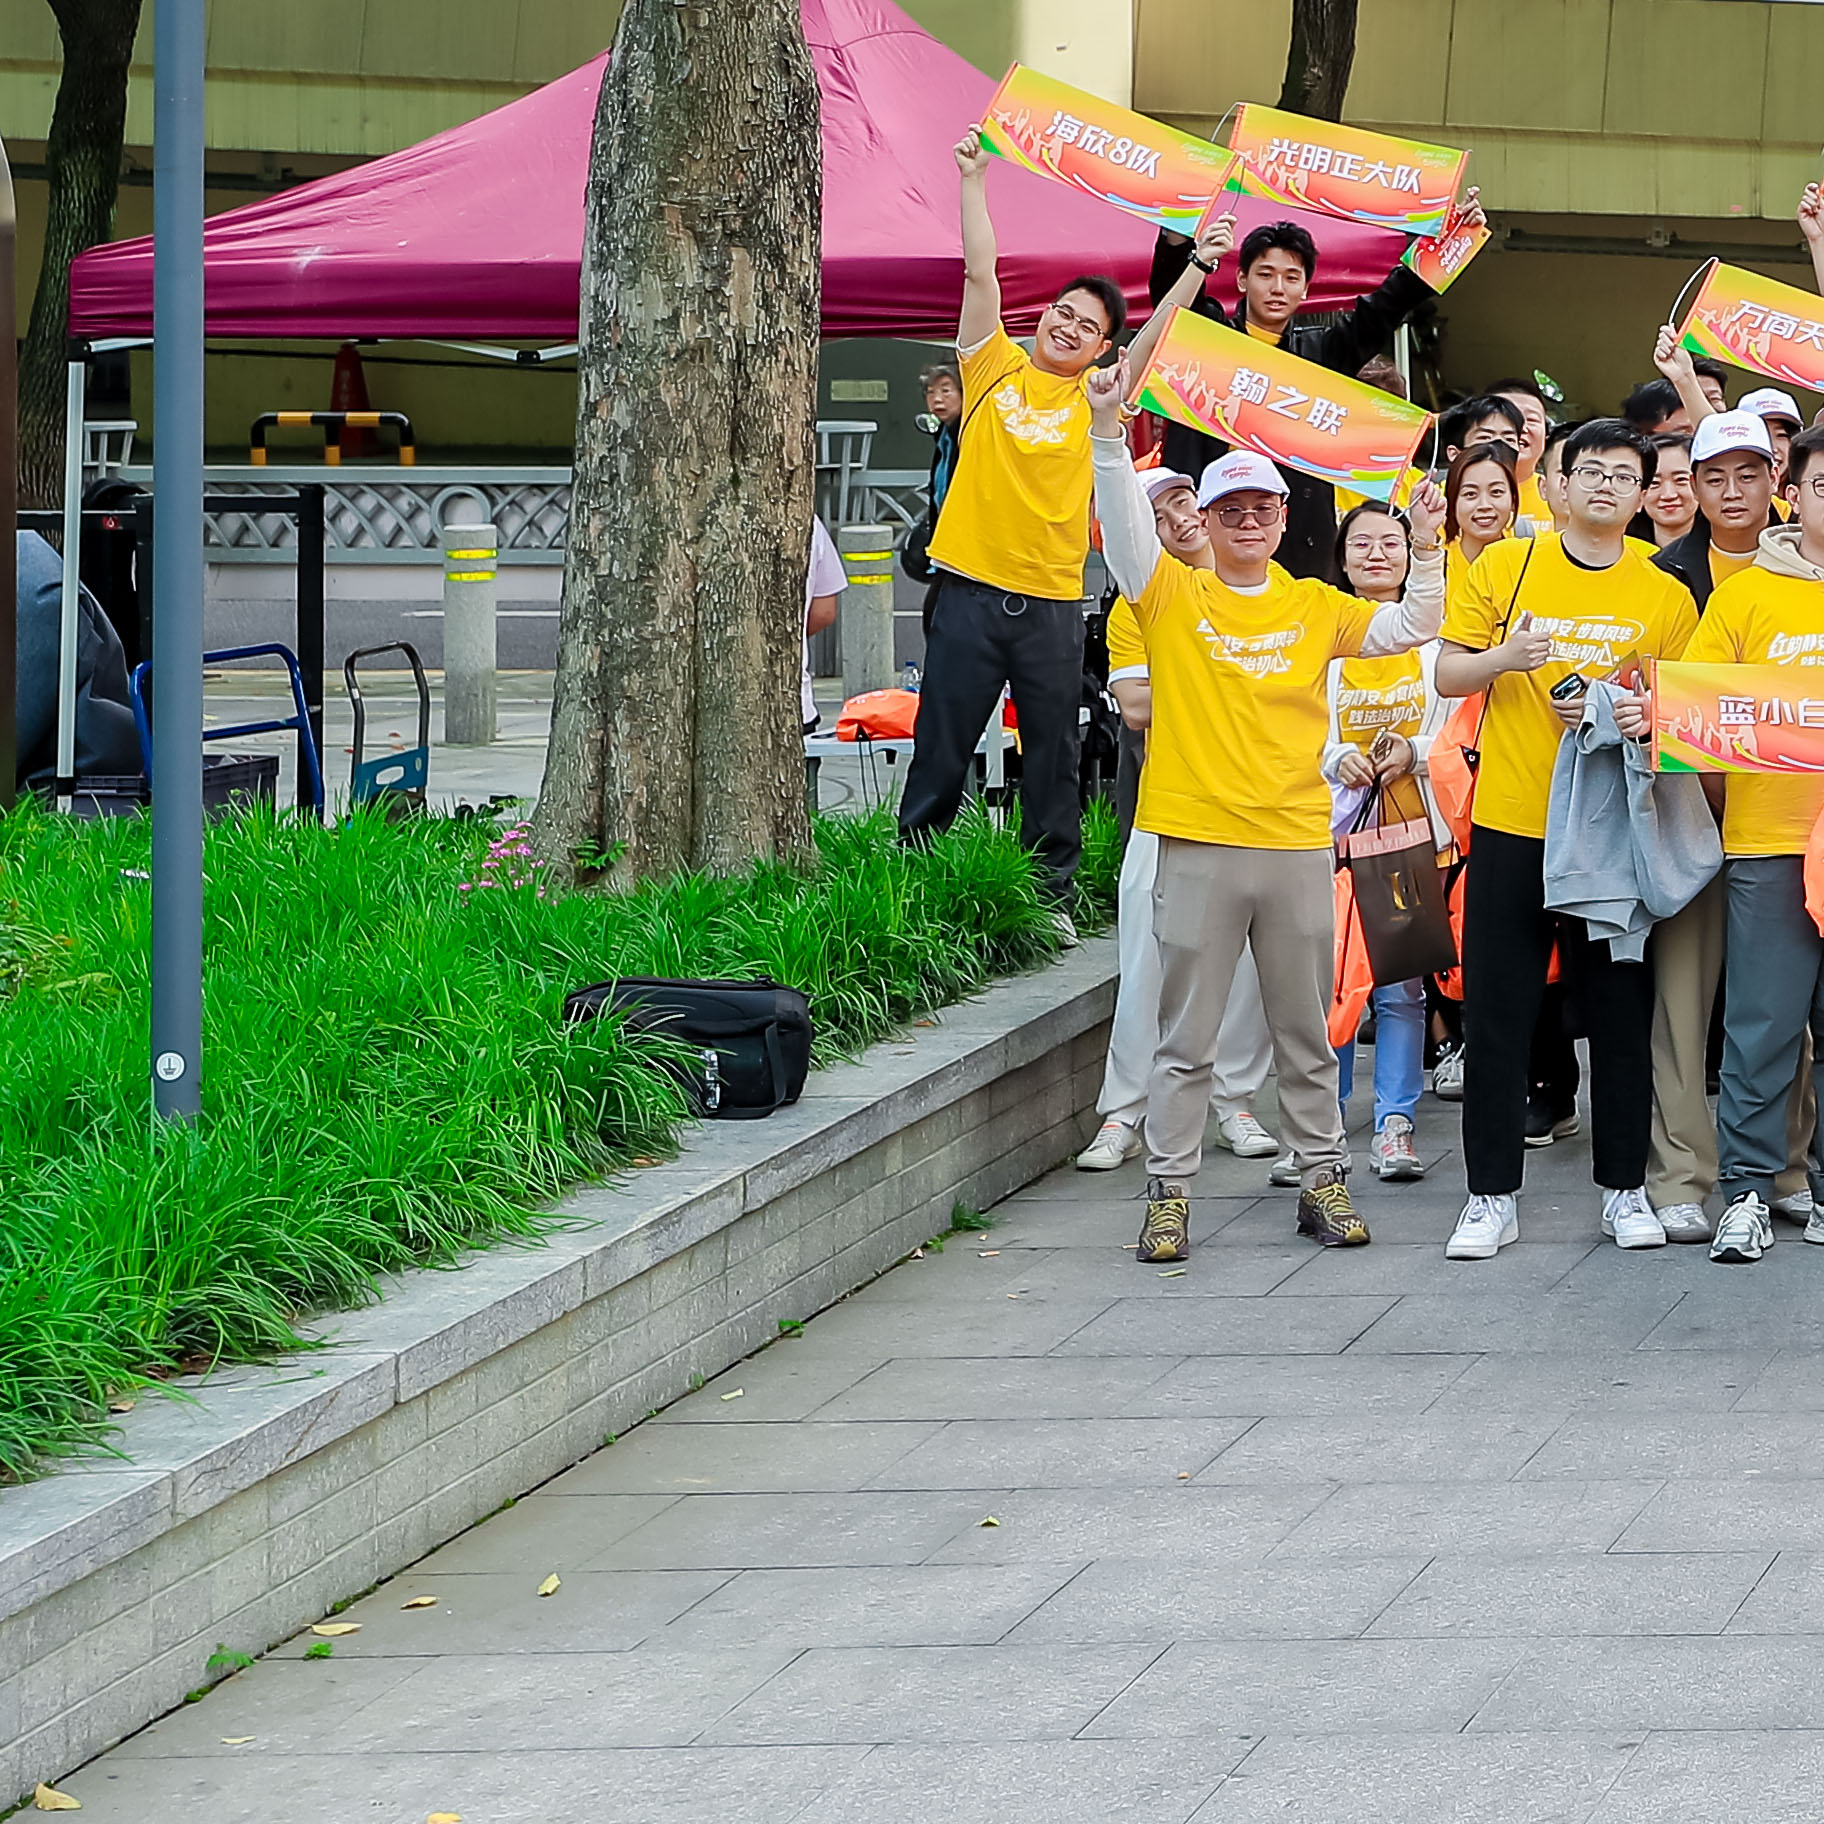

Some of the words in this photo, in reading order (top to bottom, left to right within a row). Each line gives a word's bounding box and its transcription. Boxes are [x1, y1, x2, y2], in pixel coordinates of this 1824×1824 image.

[1045, 110, 1161, 180] 海欣8队
[1267, 138, 1422, 195] 光明正大队
[1229, 366, 1348, 437] 翰之联
